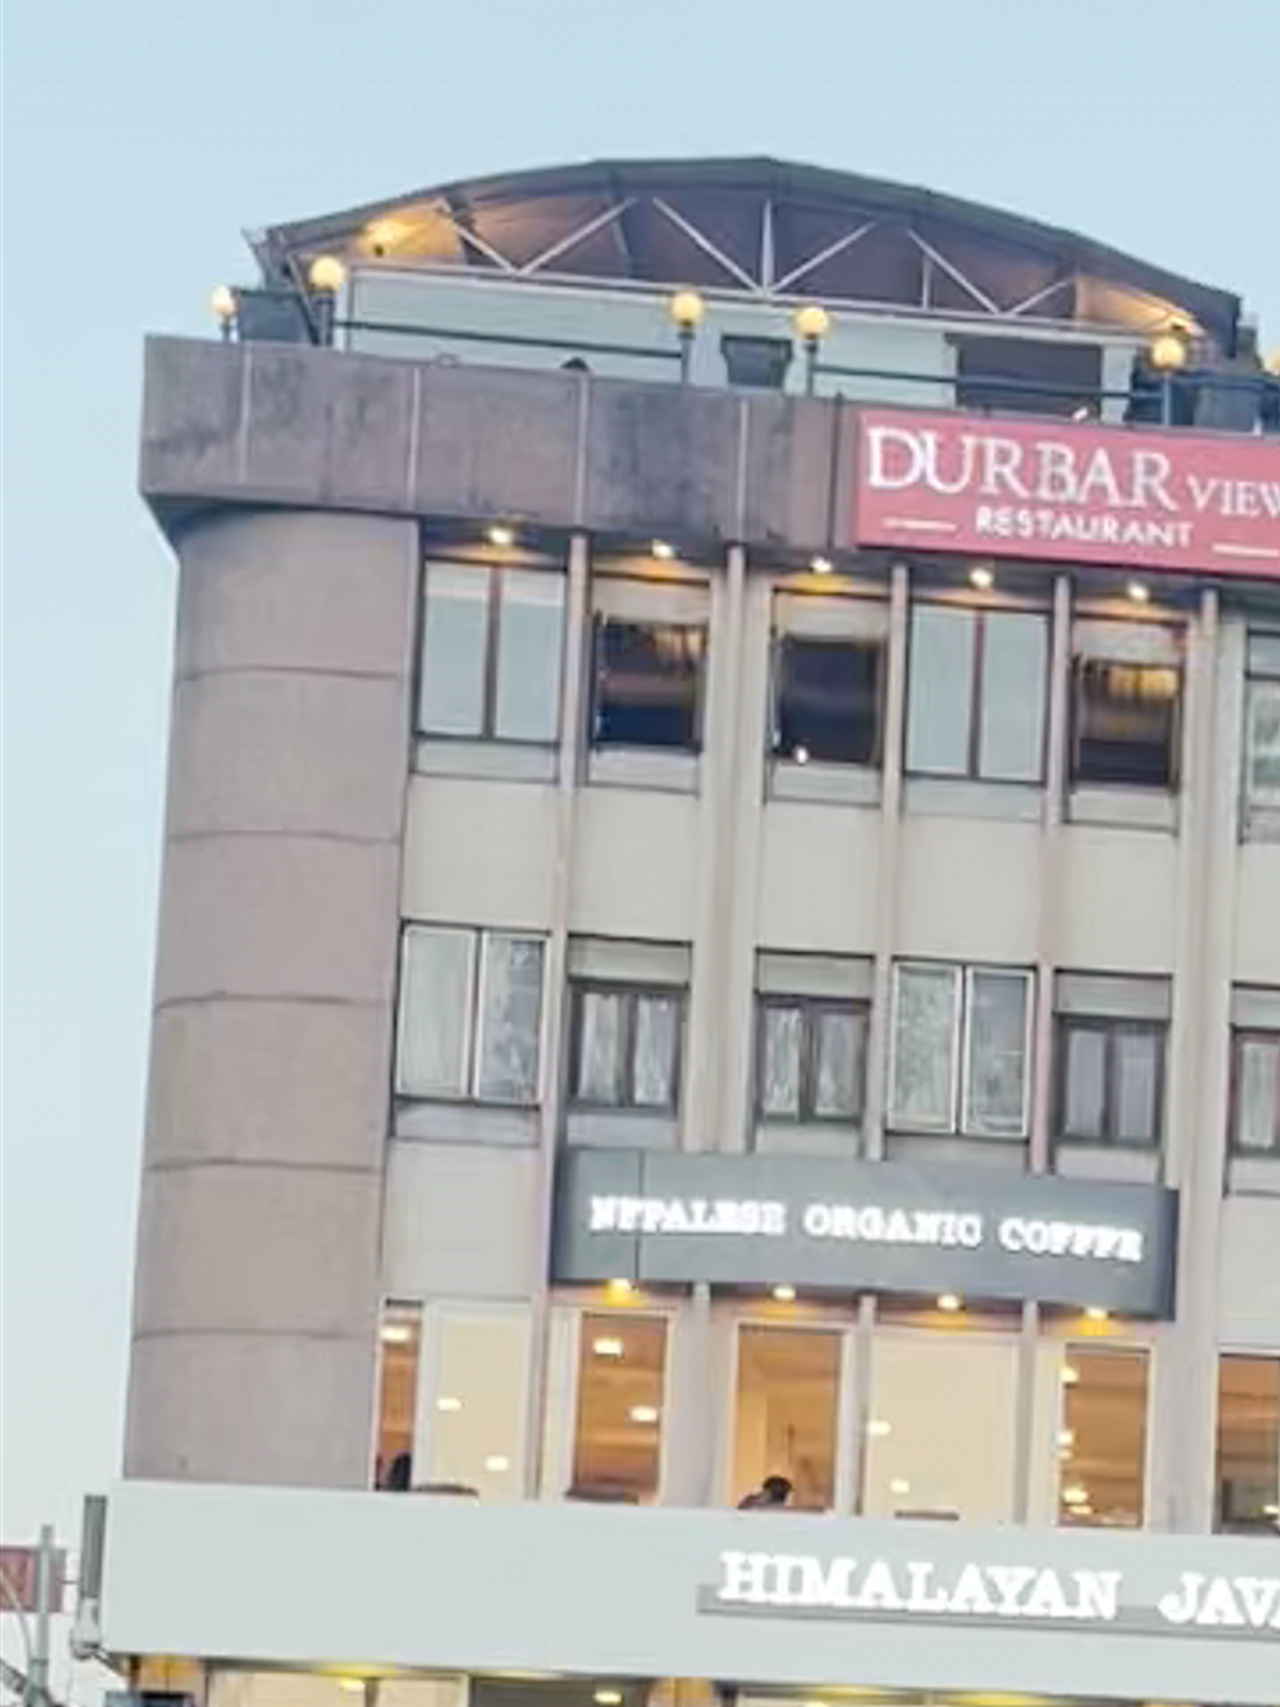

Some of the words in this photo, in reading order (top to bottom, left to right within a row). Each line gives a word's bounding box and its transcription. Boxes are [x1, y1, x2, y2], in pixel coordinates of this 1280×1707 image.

[866, 426, 1179, 512] DURBAR
[975, 506, 1194, 549] RESTAURANT
[804, 1202, 982, 1248] ORGANIC
[717, 1549, 1121, 1621] HIMALAYAN
